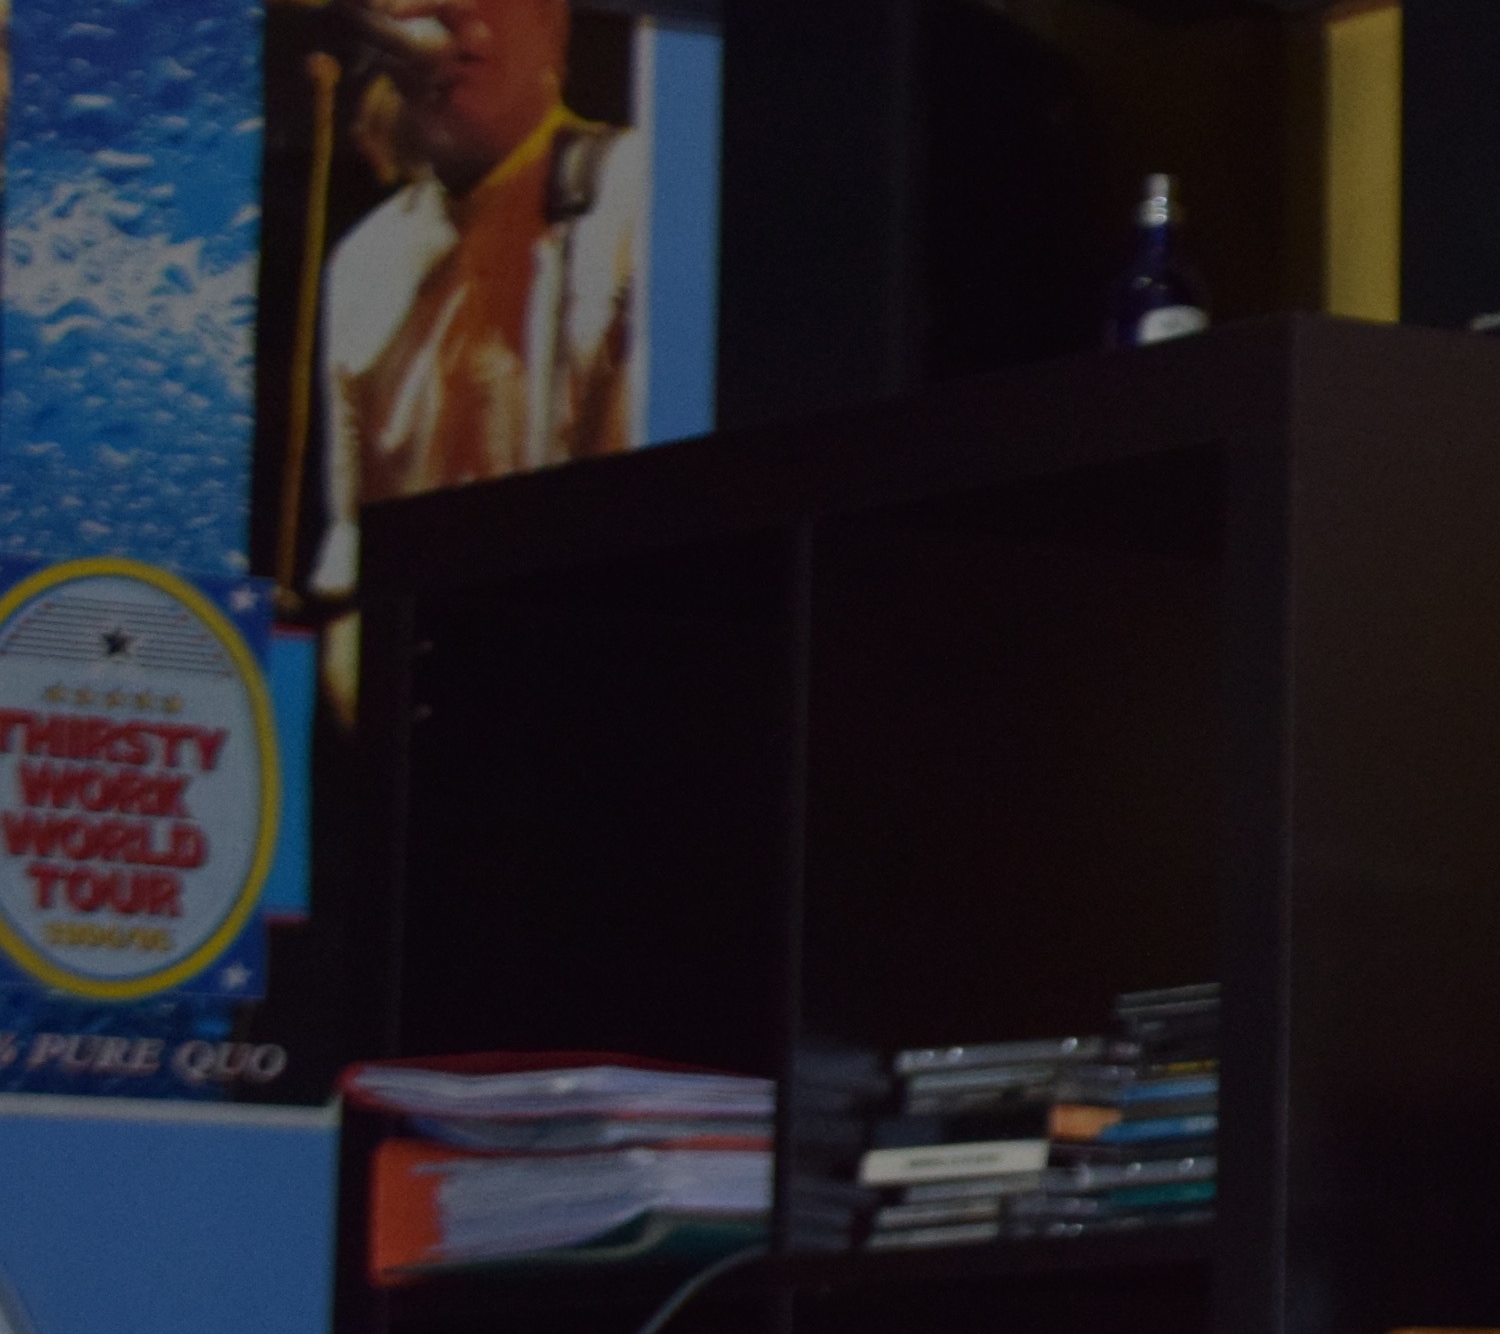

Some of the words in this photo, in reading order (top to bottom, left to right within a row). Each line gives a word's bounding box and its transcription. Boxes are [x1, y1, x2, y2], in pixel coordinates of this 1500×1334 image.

[0, 707, 229, 771] THIRSTY
[18, 760, 192, 818] WORK
[0, 811, 209, 870] WORLD
[26, 863, 184, 919] TOUR
[28, 1031, 166, 1075] PURE
[171, 1038, 289, 1083] QUO
